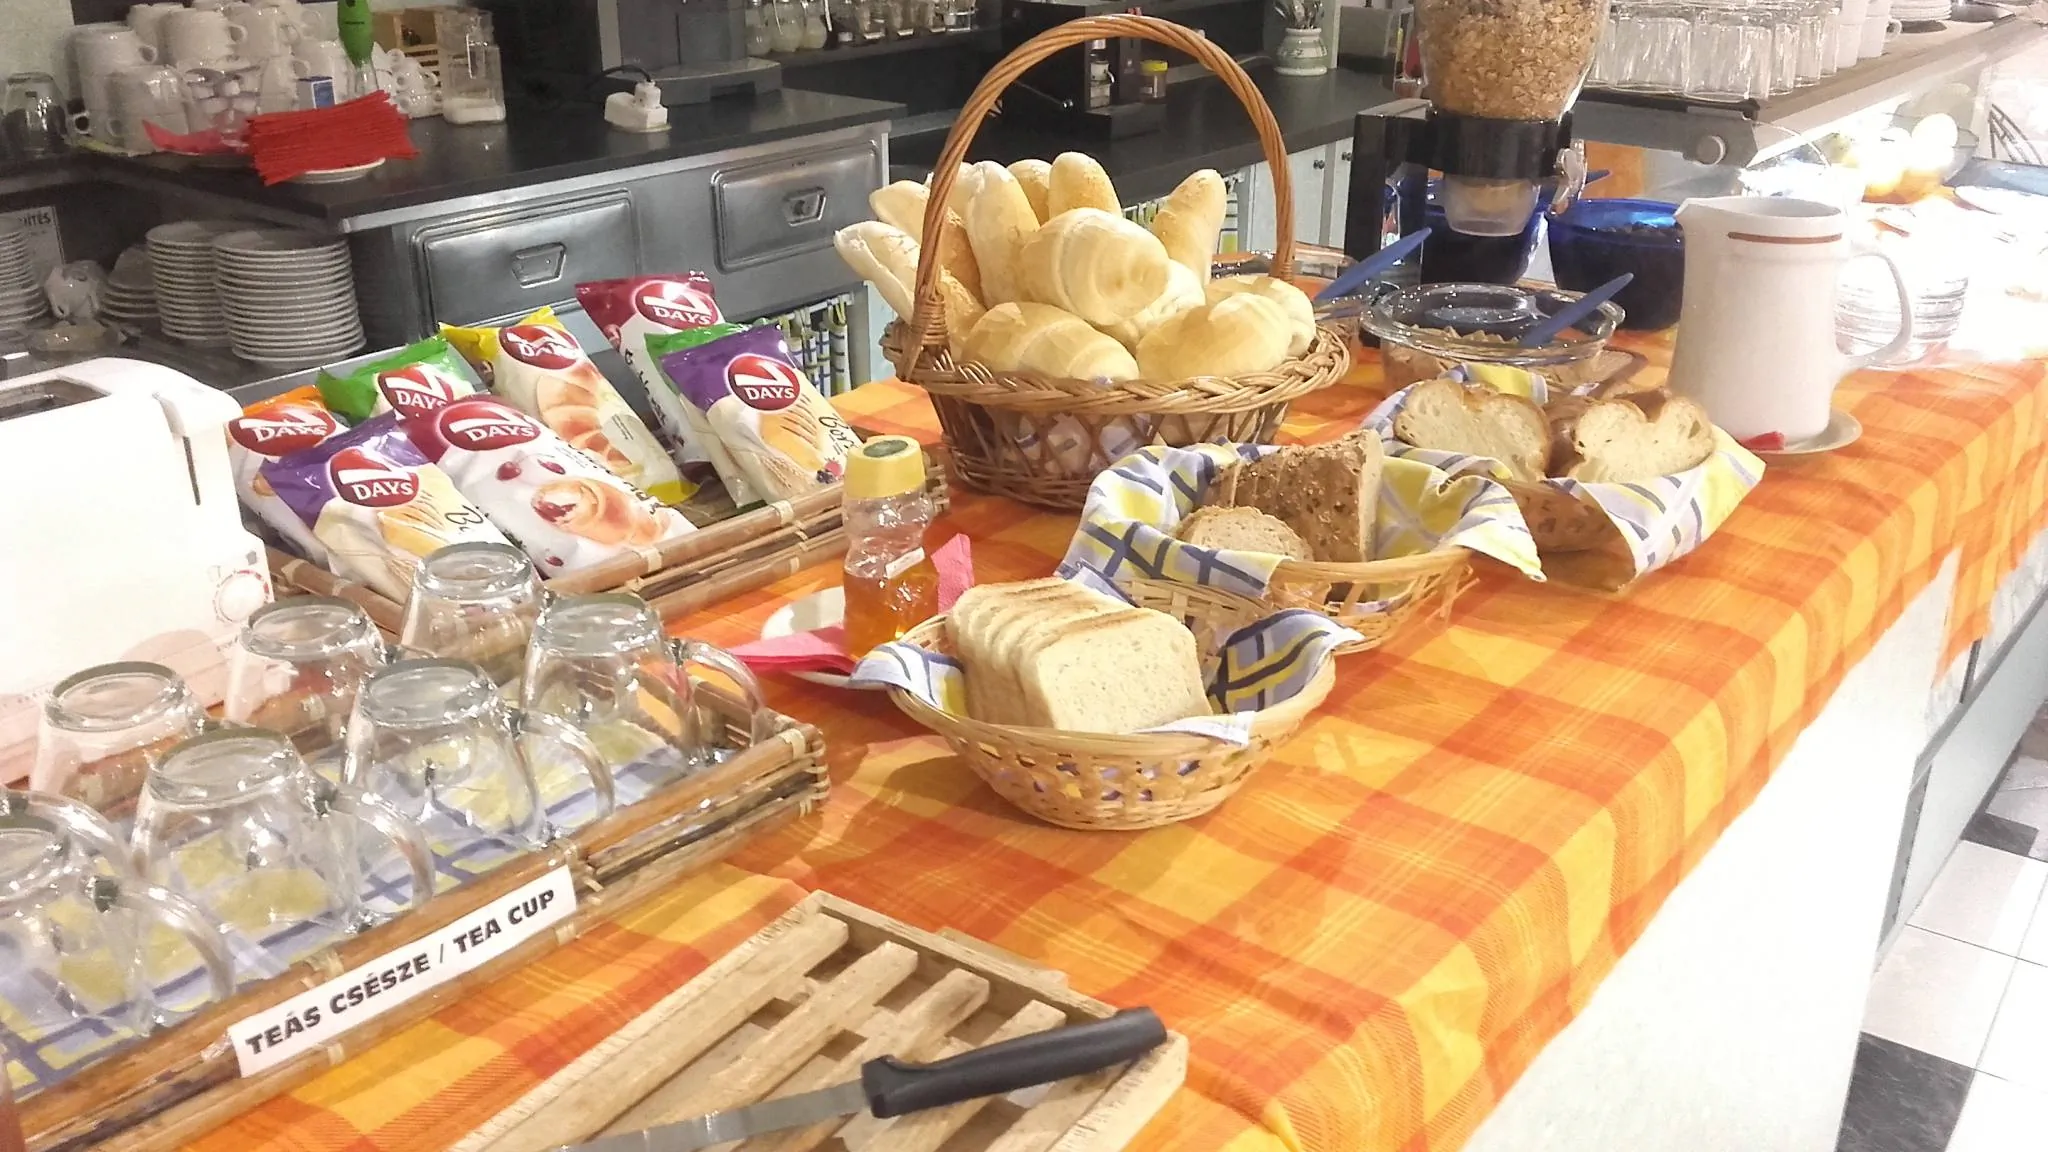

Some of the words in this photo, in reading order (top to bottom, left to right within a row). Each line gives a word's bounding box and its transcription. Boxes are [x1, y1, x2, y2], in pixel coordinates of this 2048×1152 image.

[652, 305, 713, 326] DAYS
[744, 386, 795, 400] DAYS
[465, 426, 536, 442] DAYS
[352, 480, 415, 501] DAYS
[245, 1011, 321, 1055] TEÁS
[329, 953, 431, 1014] CSÉSZE
[453, 918, 502, 953] TEA
[507, 890, 555, 925] CUP
